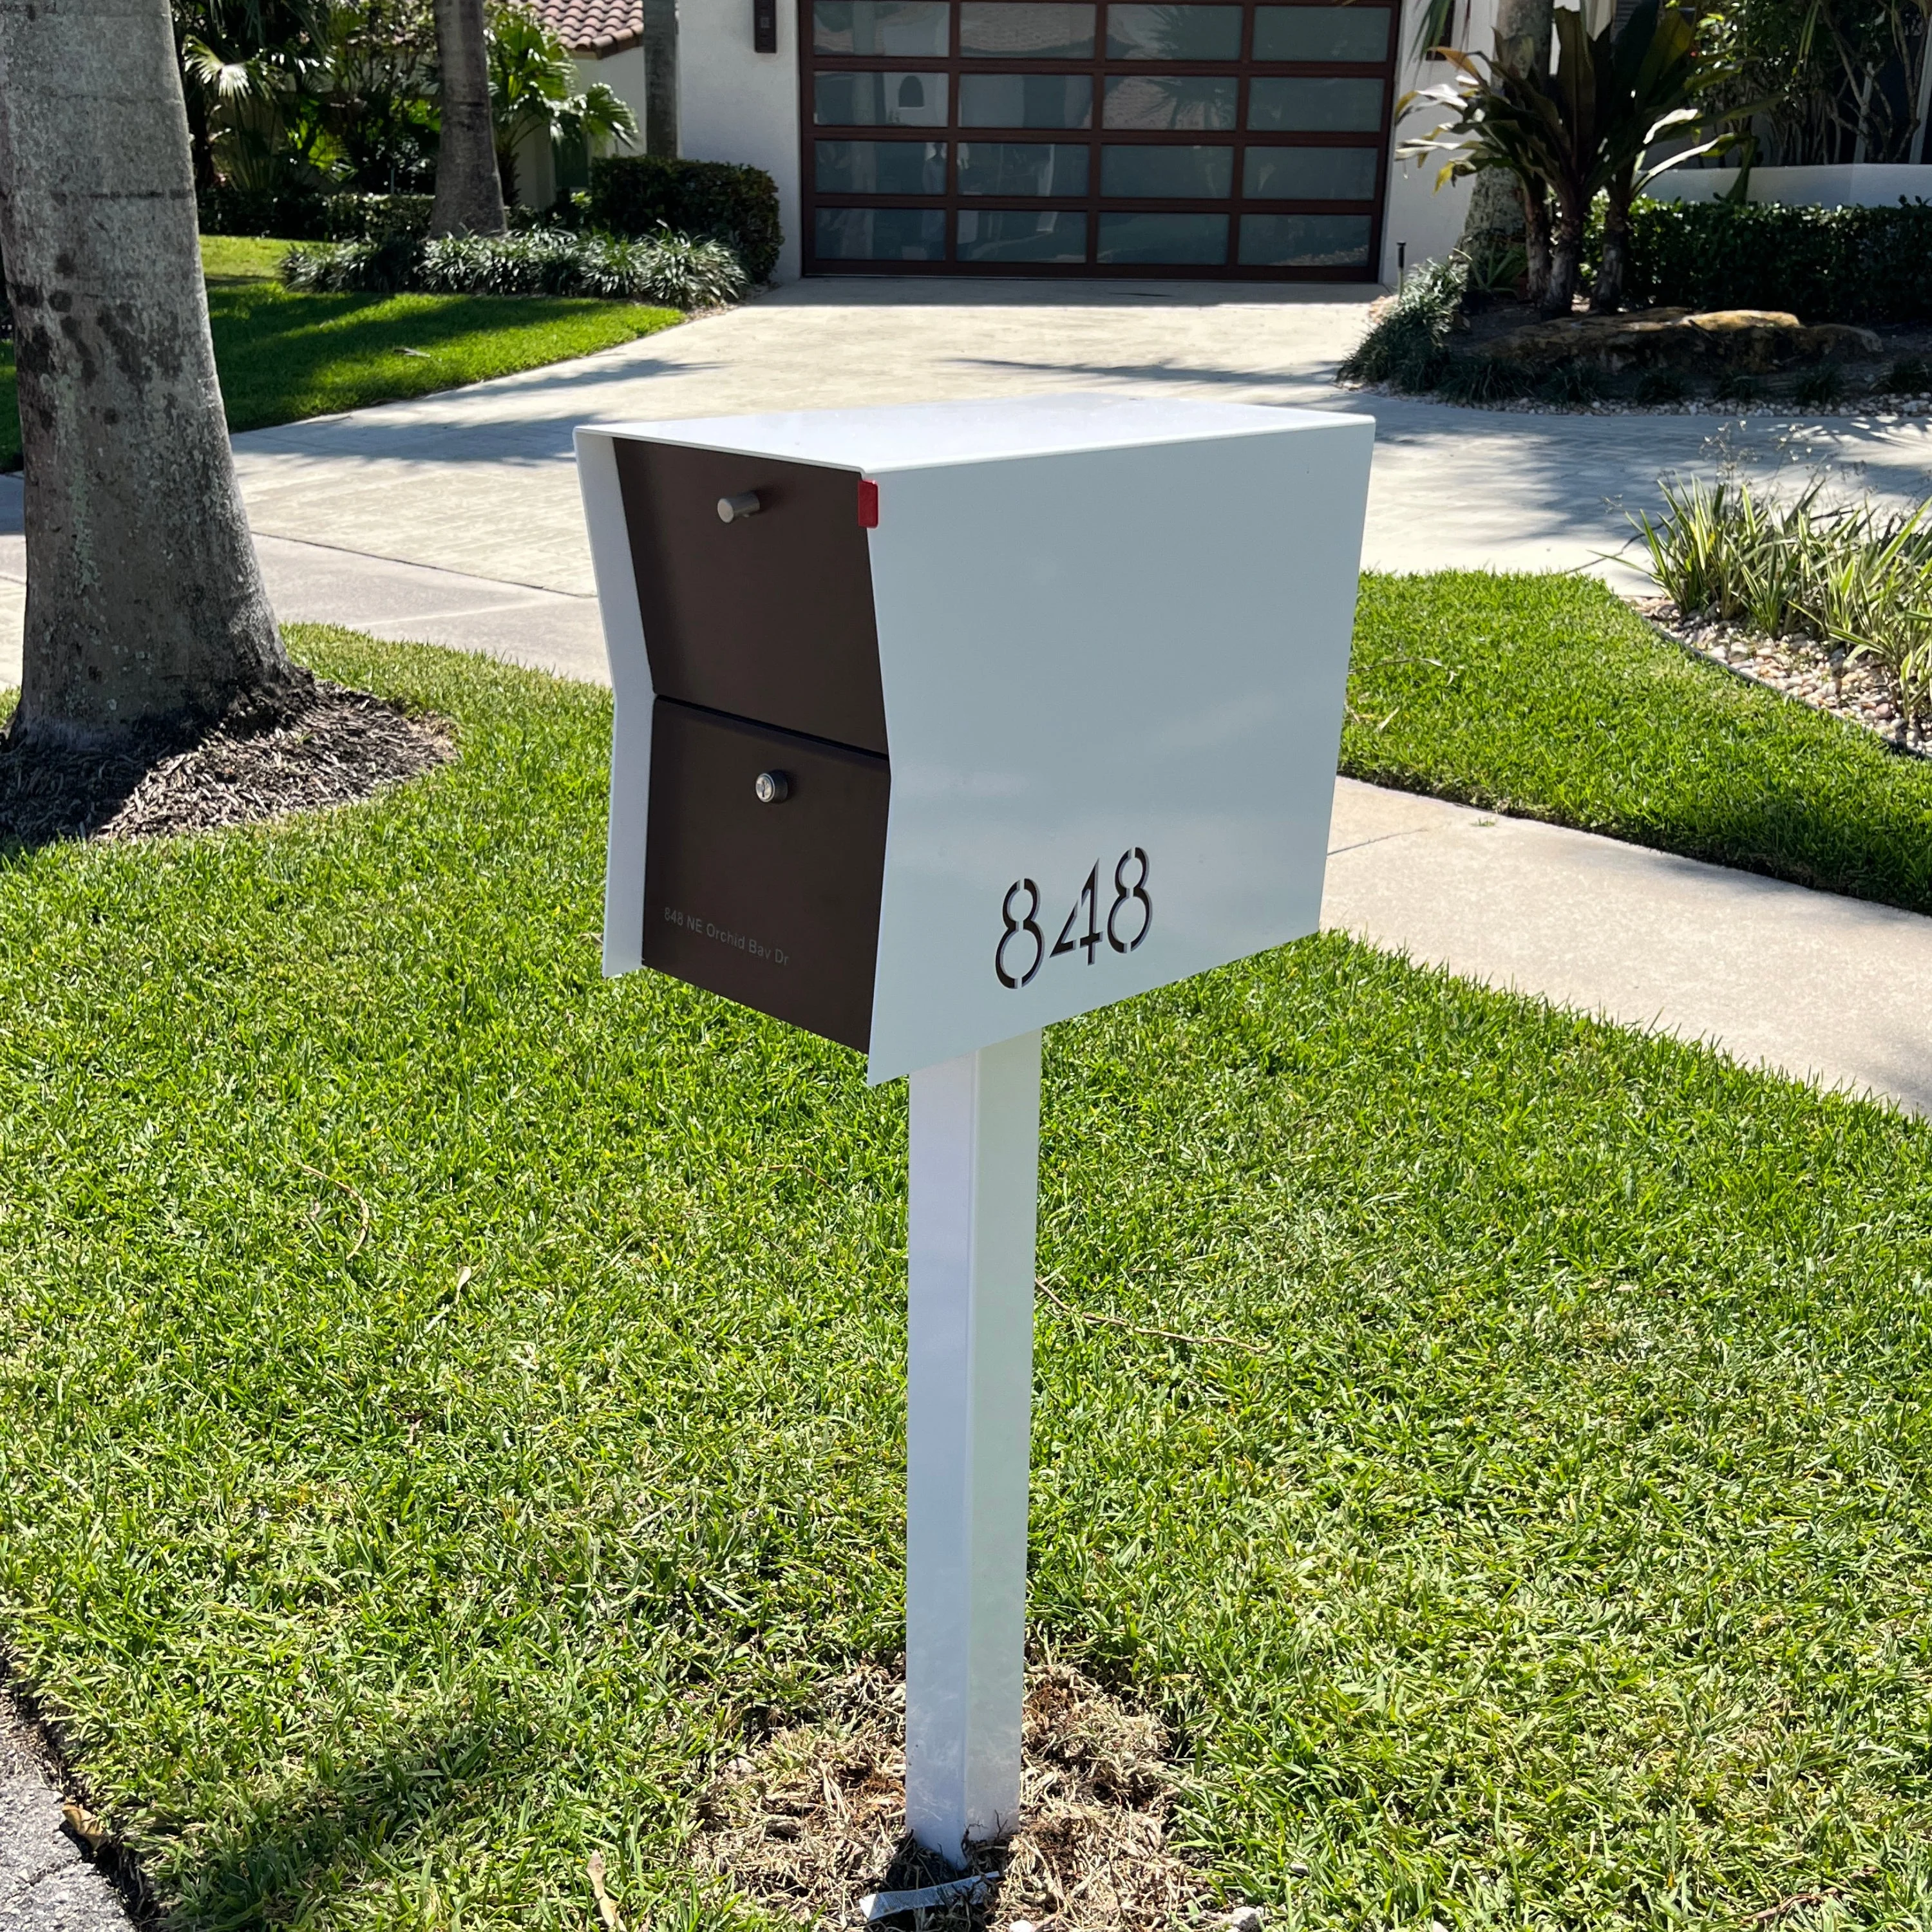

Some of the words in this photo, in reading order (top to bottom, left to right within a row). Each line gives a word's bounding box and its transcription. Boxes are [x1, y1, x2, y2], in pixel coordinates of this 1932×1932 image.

[665, 907, 683, 926] 848
[687, 915, 703, 933] NE
[706, 923, 745, 949] Orchid
[775, 949, 789, 966] Dr
[995, 846, 1153, 989] 848
